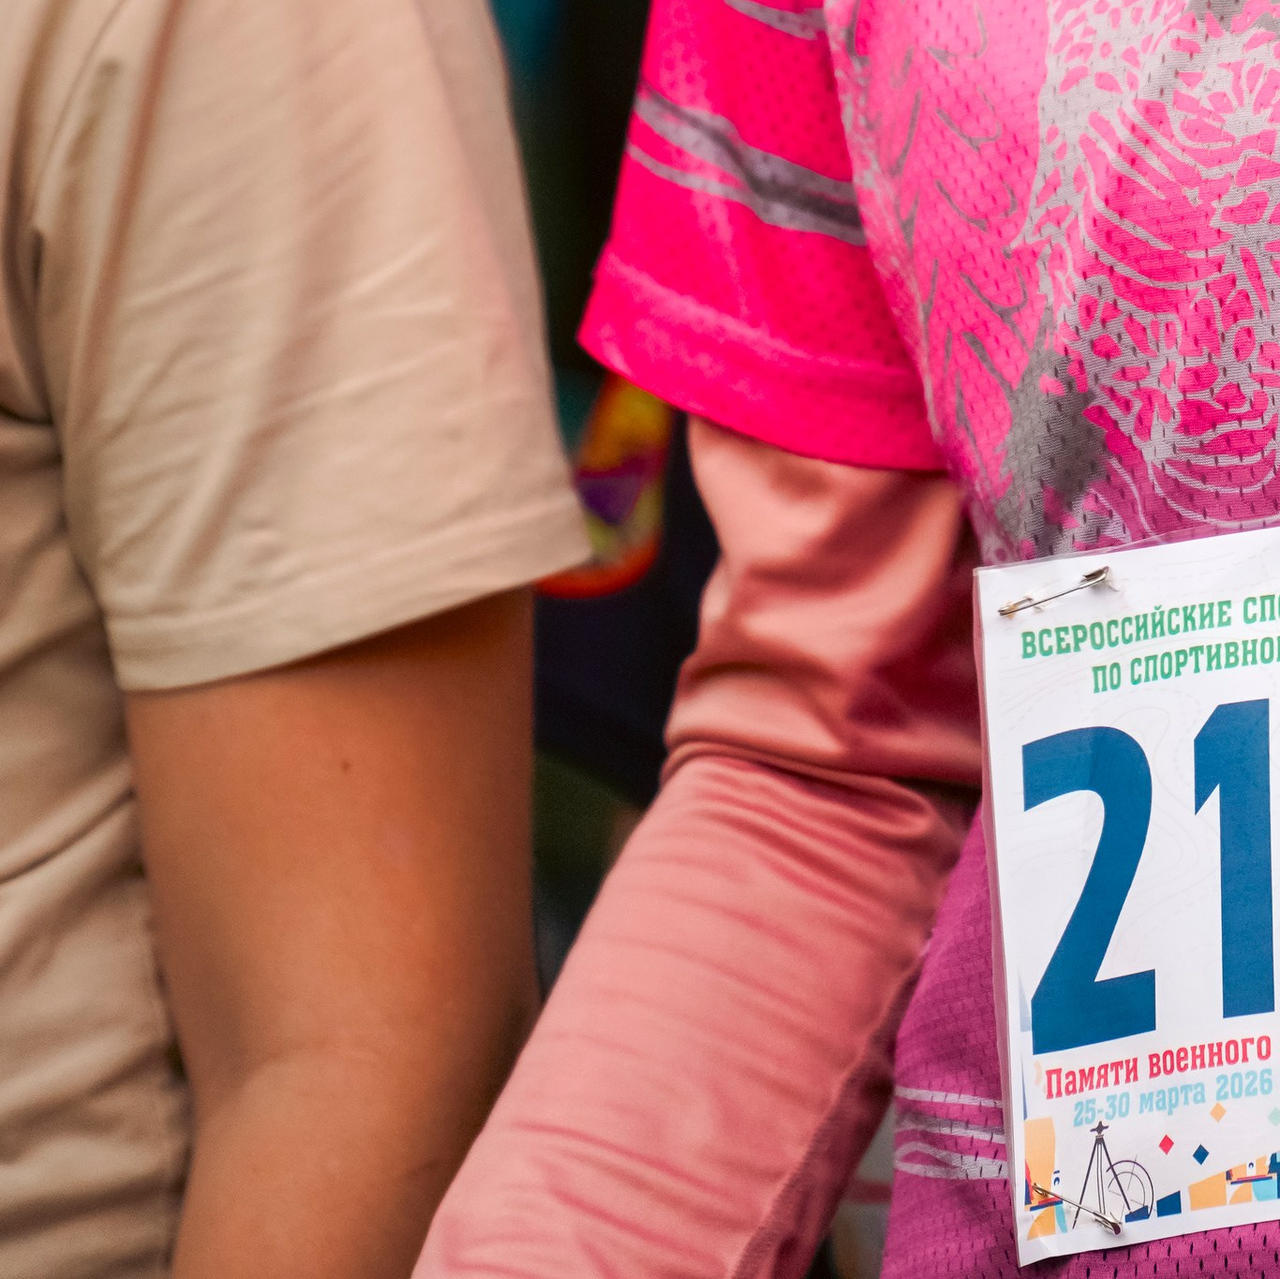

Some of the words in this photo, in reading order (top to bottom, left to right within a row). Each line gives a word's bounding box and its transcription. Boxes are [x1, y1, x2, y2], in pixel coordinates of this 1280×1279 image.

[1021, 599, 1232, 659] ВСЕРОССИЙСКИЕ
[1092, 661, 1121, 693] ПО
[1045, 1057, 1139, 1100] Памяти
[1148, 1035, 1272, 1079] военного
[1073, 1091, 1131, 1128] 25-30
[1138, 1082, 1206, 1116] марта
[1215, 1068, 1273, 1101] 2026
